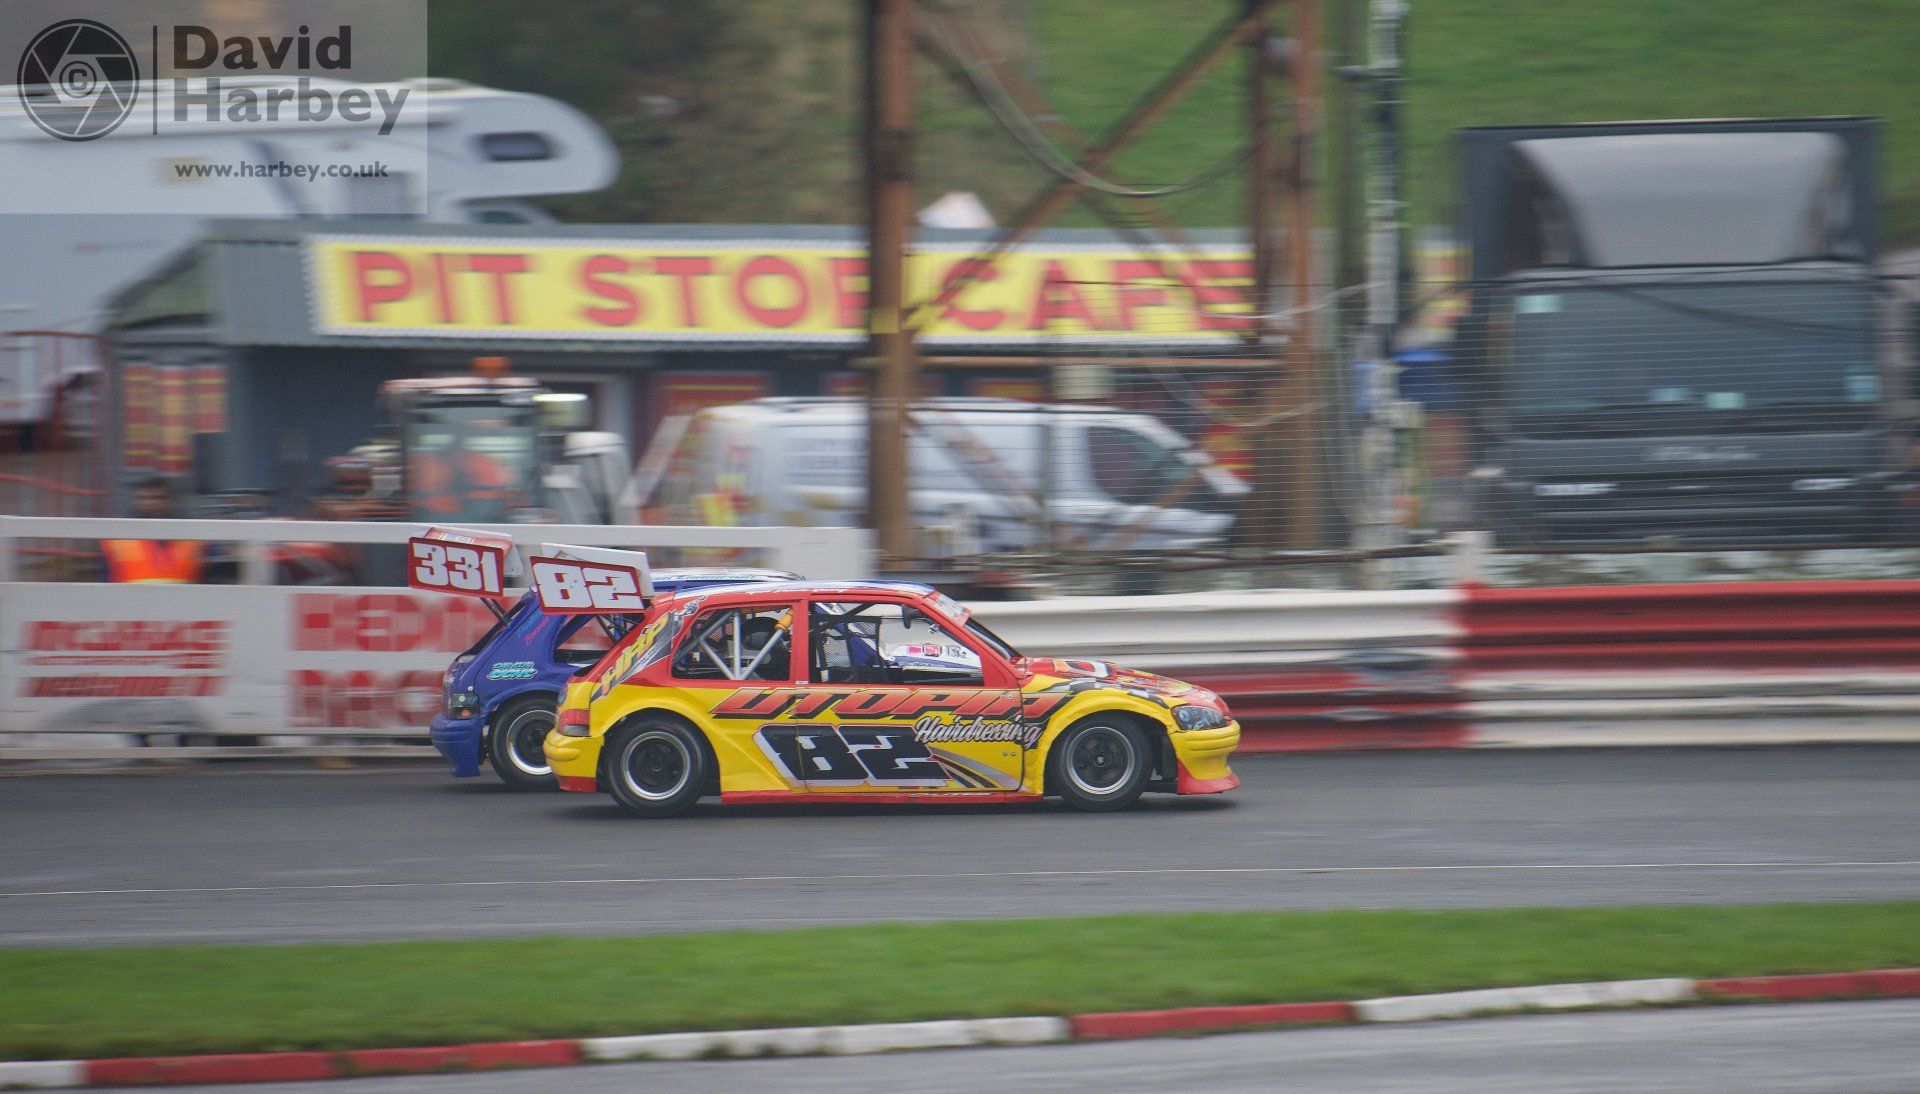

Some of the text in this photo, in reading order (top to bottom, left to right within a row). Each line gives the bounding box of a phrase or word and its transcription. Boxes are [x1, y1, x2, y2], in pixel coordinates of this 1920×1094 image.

[353, 251, 529, 324] PIT
[932, 258, 1256, 331] CAFE
[413, 542, 499, 593] 331
[532, 563, 644, 609] 82
[708, 688, 1072, 720] UTOPIA
[754, 724, 952, 786] 82
[914, 715, 1042, 750] Hairdressing
